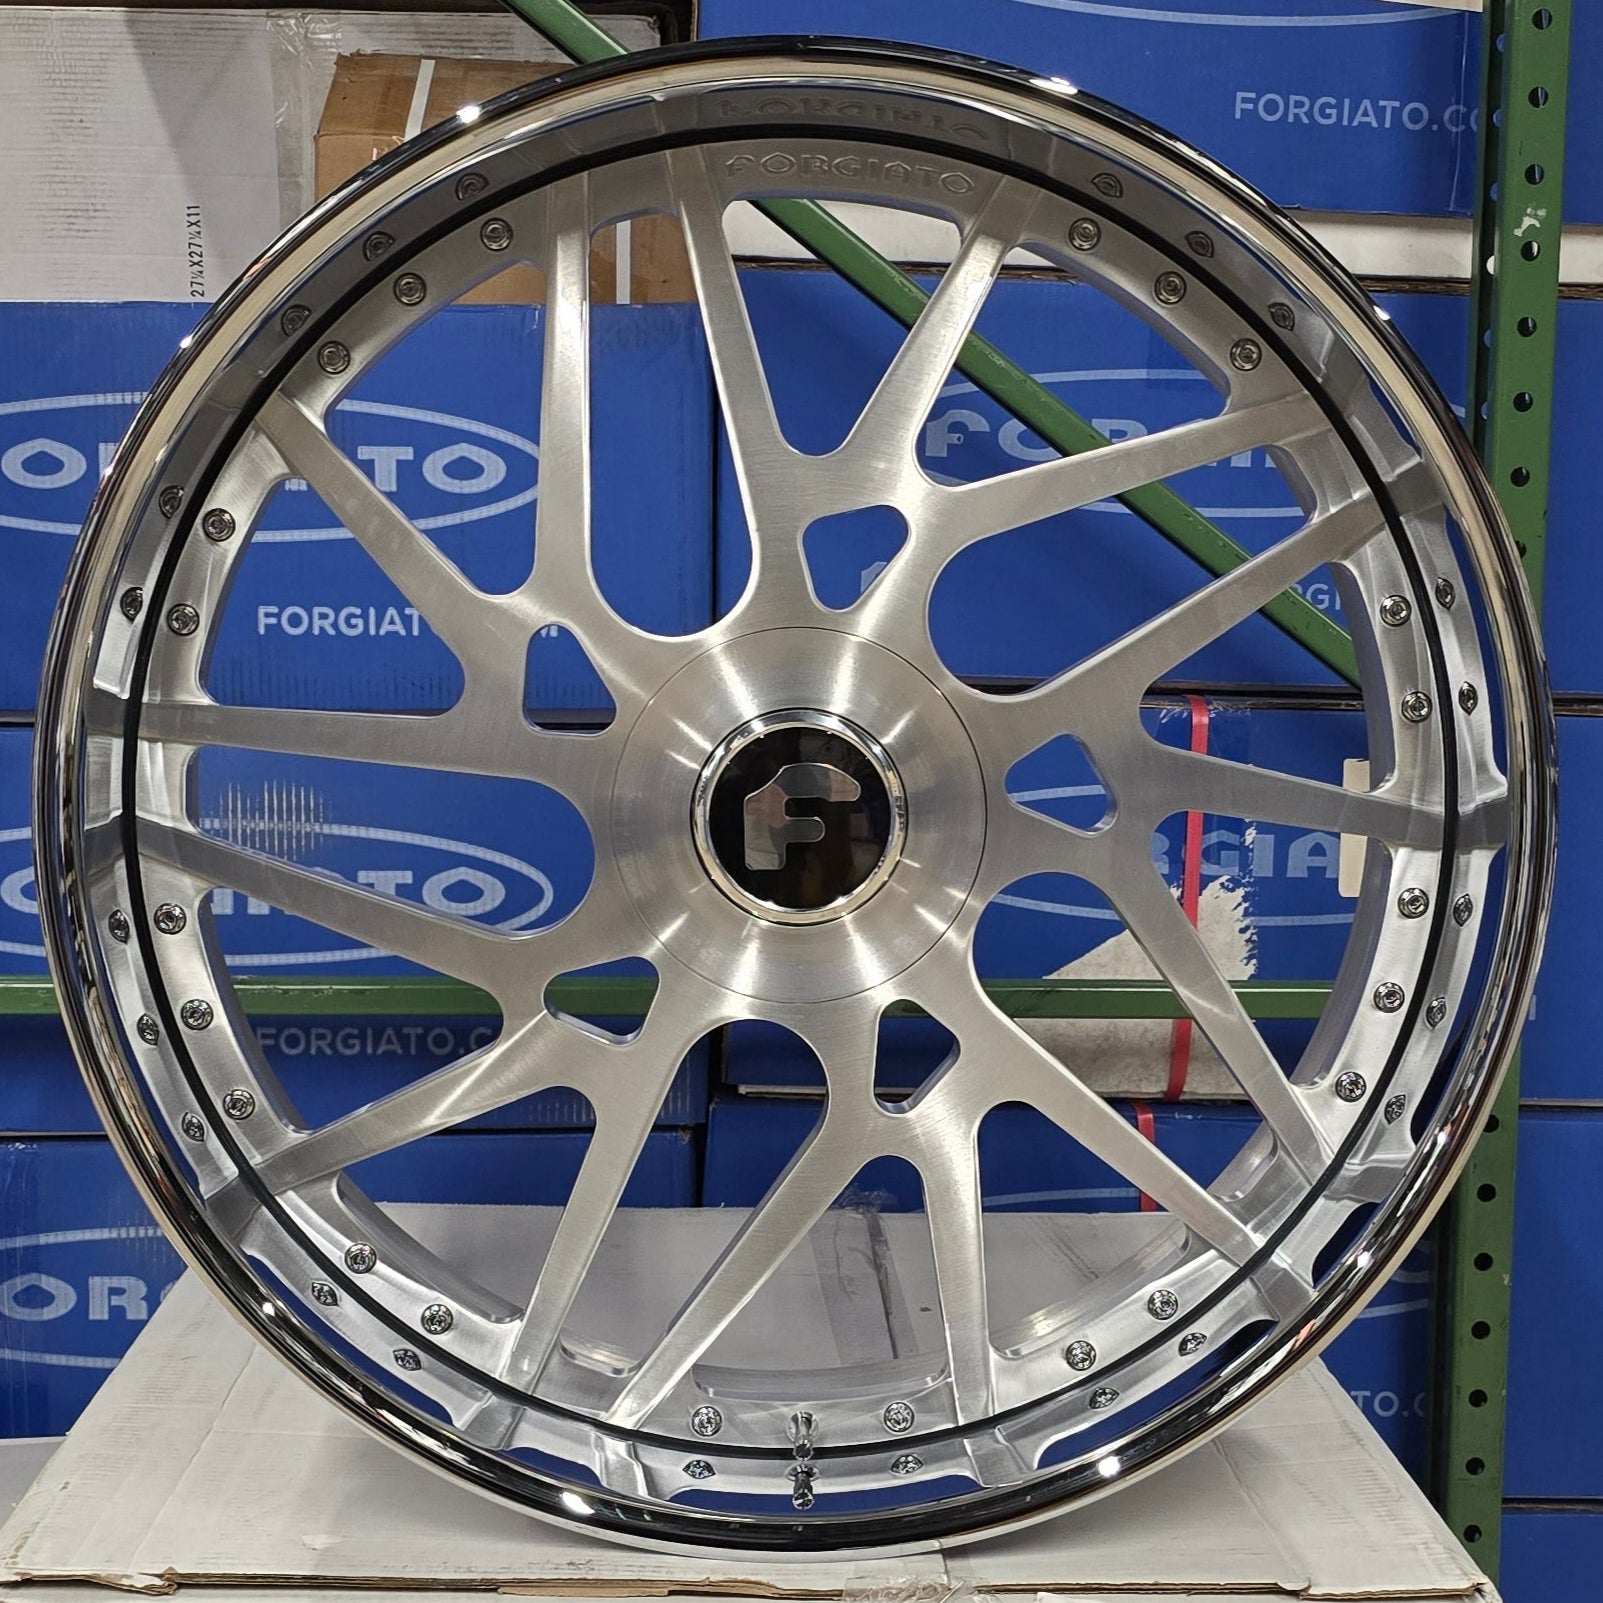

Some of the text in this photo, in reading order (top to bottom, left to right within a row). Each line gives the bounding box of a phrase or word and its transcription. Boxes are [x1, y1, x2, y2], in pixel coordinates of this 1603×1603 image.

[1235, 91, 1477, 133] FORGIATO.C
[725, 152, 975, 193] FORGIATO
[257, 605, 422, 637] FORGIAT
[256, 1027, 493, 1056] FORGIATO.C
